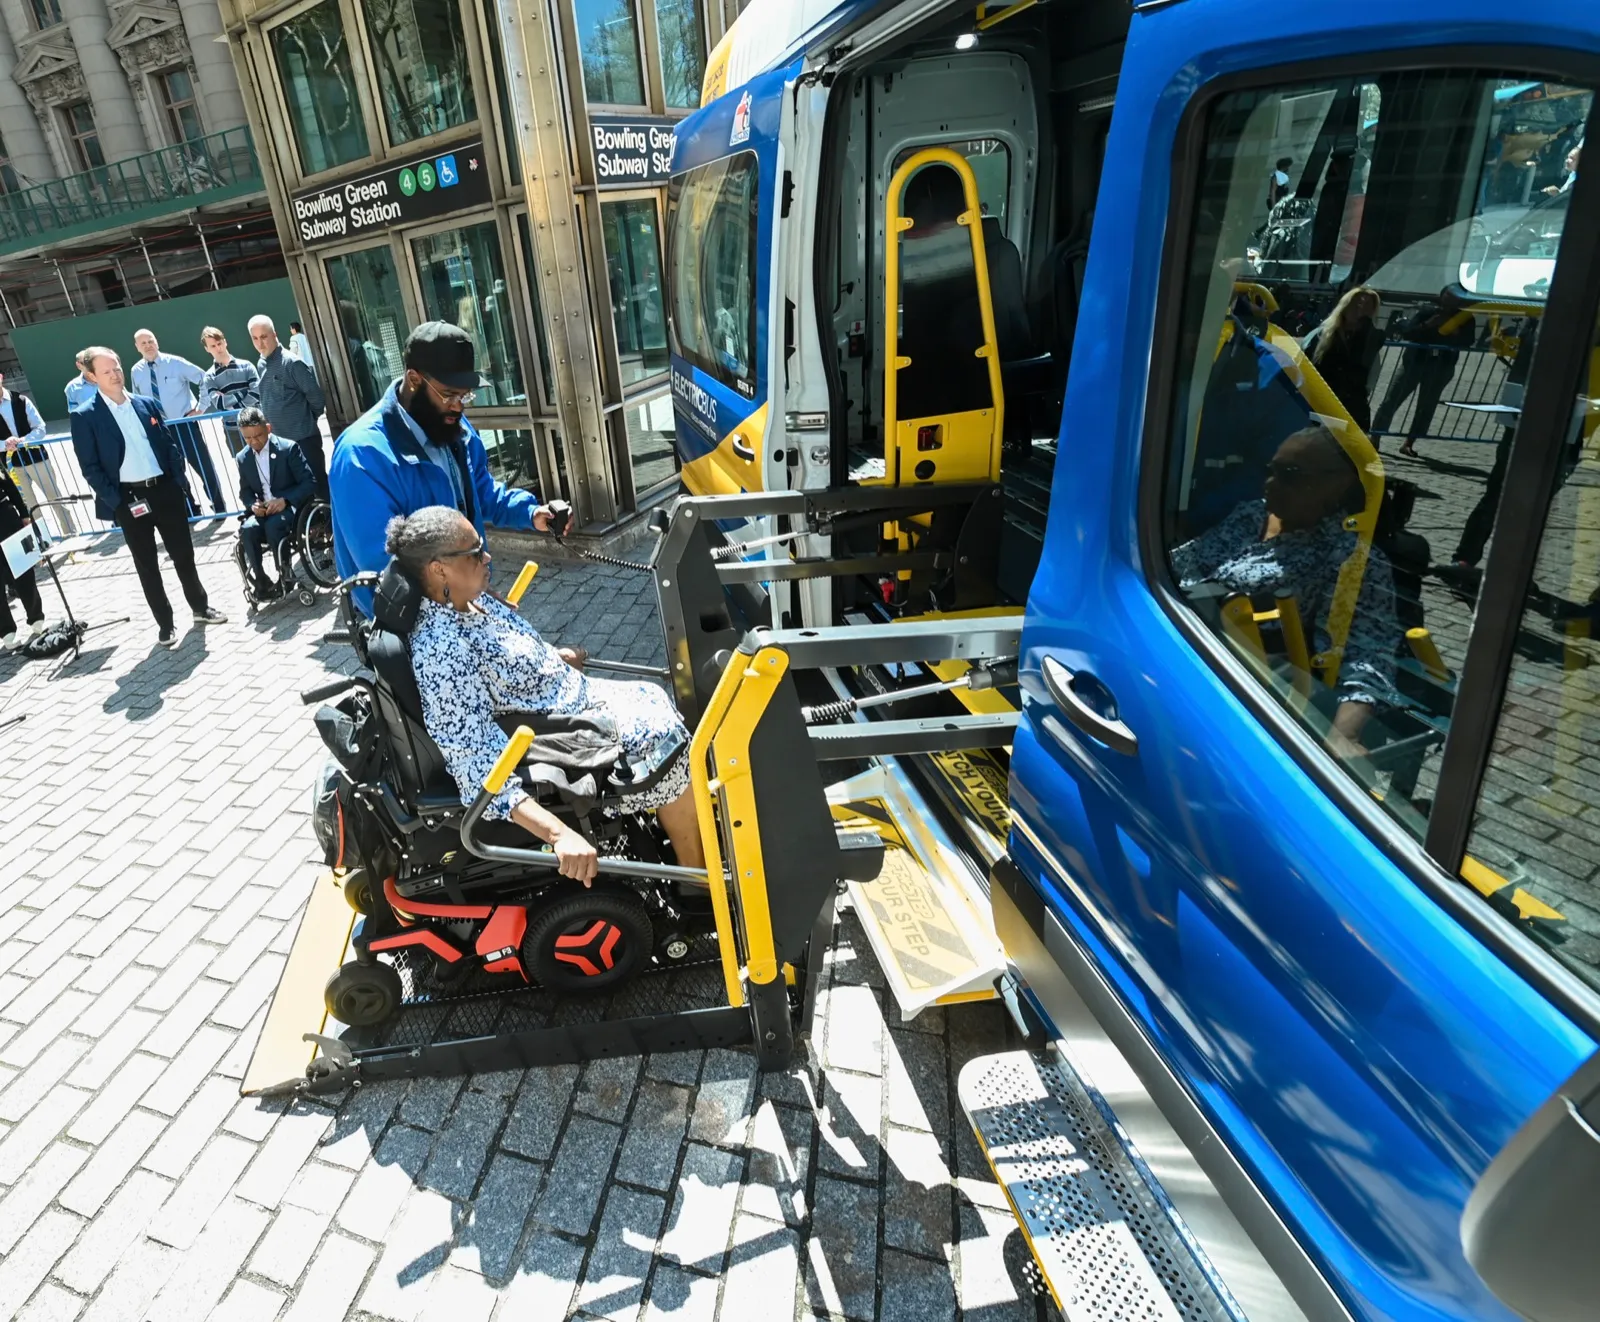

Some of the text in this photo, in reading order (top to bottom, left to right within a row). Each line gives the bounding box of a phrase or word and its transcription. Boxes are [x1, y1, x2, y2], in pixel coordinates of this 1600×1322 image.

[594, 127, 647, 154] Bowling
[598, 153, 649, 178] Subway
[295, 192, 343, 219] Bowling
[344, 180, 388, 205] Green
[422, 169, 431, 186] 5
[301, 201, 402, 241] Subway Station
[970, 781, 1007, 822] YOUR
[877, 871, 904, 907] OUR
[895, 912, 930, 956] STEP
